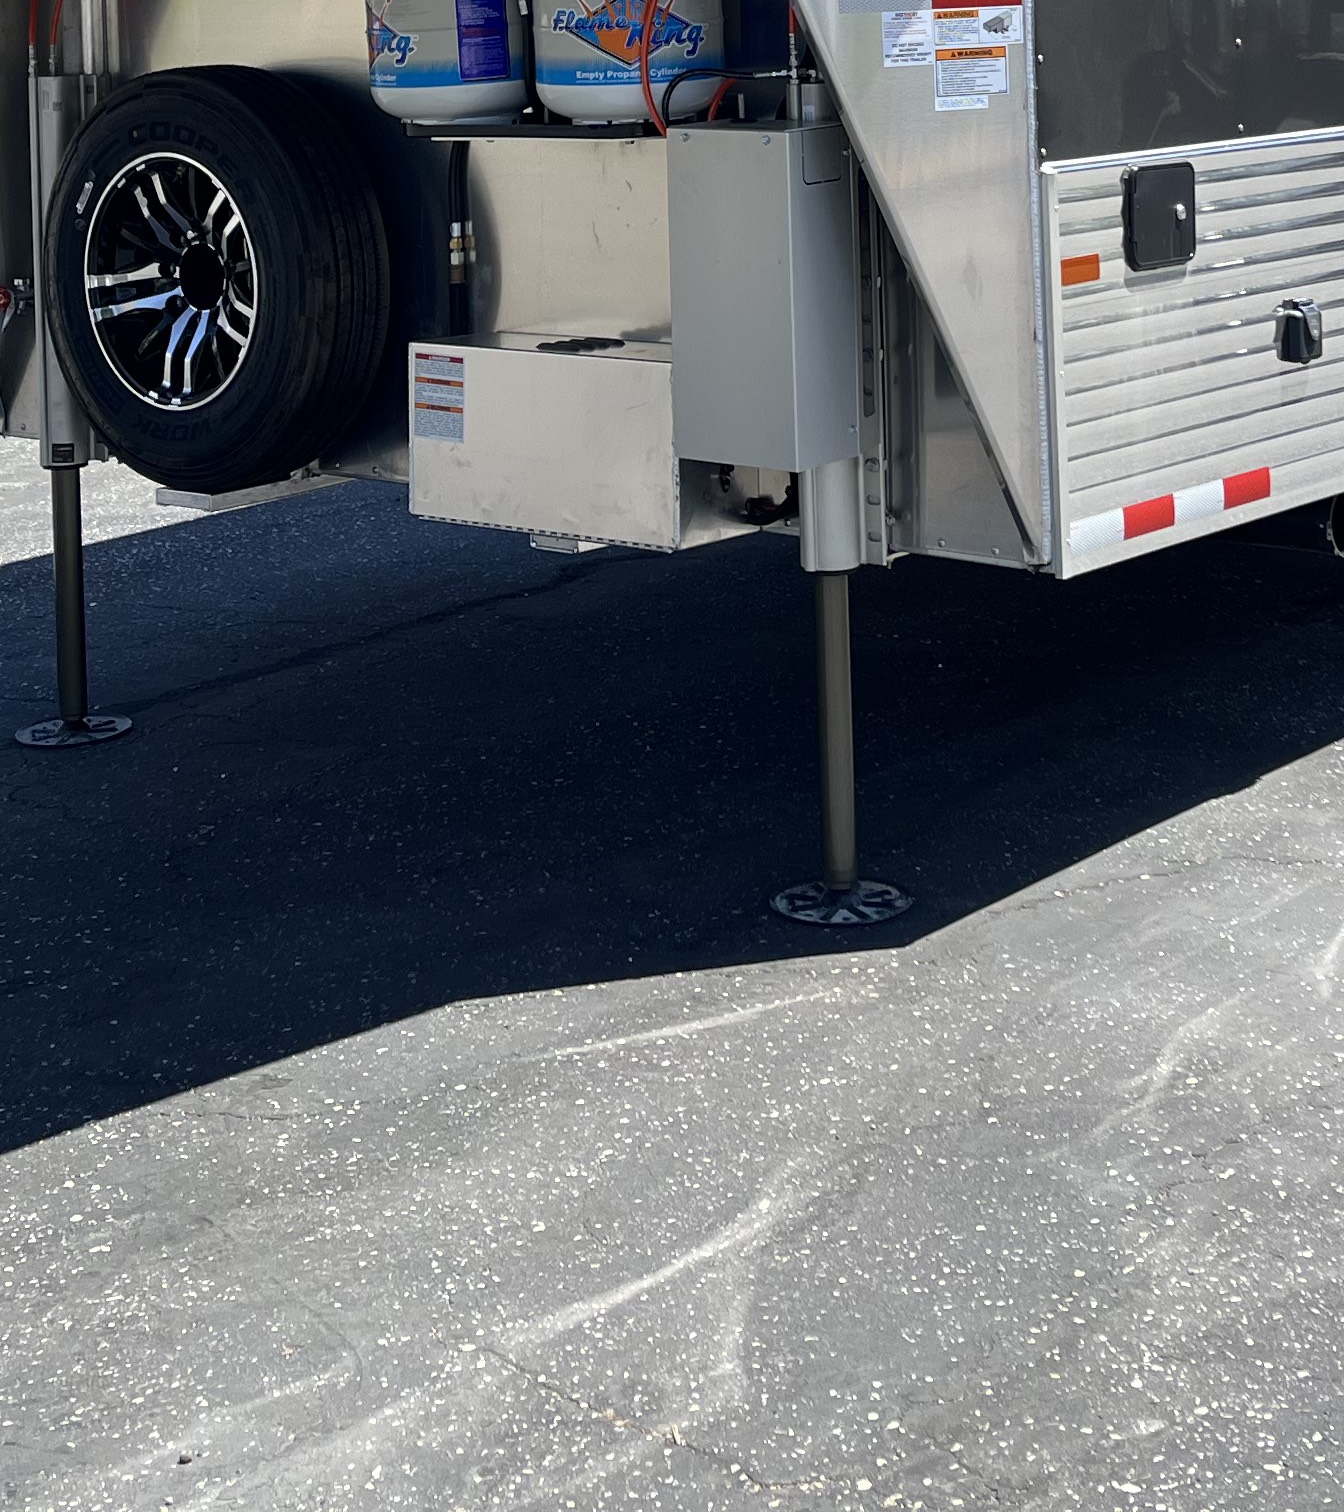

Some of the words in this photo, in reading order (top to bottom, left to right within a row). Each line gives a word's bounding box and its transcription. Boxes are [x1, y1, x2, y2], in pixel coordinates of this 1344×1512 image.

[552, 9, 629, 33] Flame
[576, 71, 605, 81] Empty
[607, 70, 641, 80] Propan
